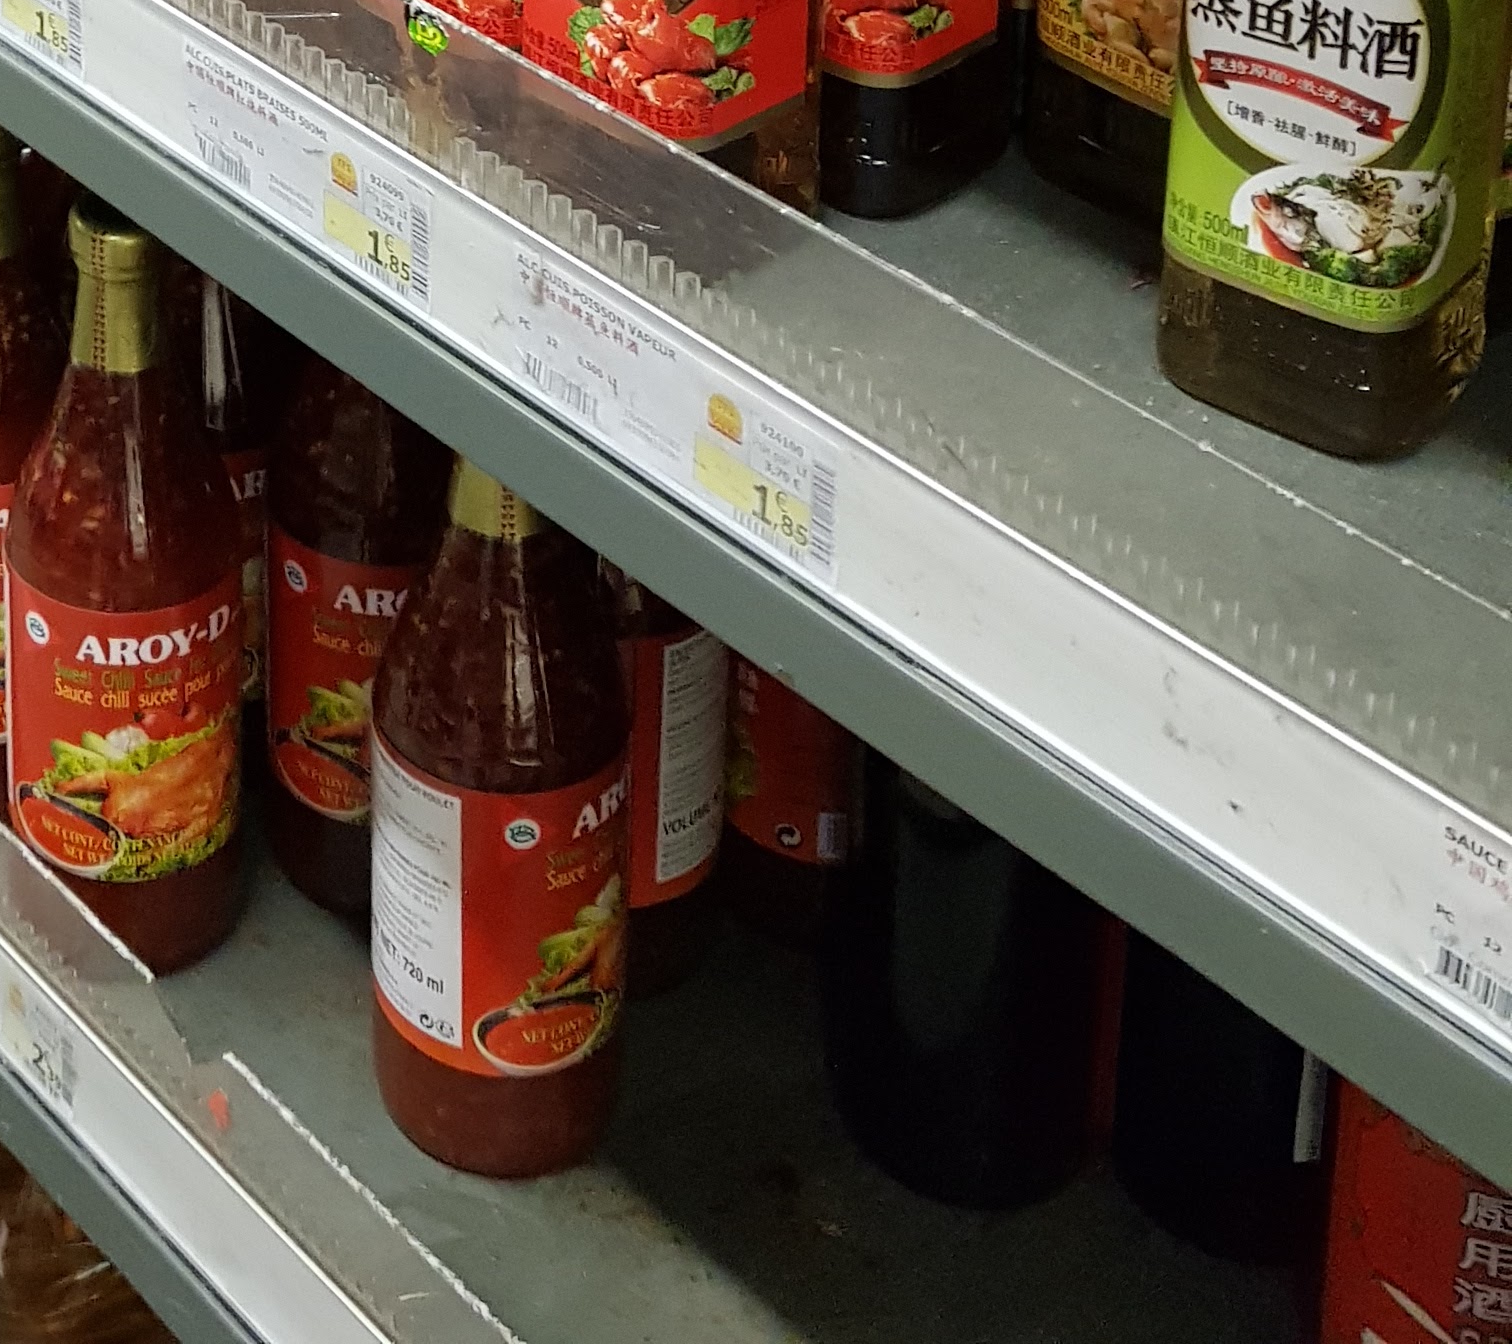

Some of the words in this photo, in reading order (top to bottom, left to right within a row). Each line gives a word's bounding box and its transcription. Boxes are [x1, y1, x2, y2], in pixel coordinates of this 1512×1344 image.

[256, 88, 296, 122] BRAISES
[298, 113, 330, 144] 500ML
[369, 173, 405, 202] 924095
[1202, 210, 1249, 244] 500ml
[628, 320, 678, 362] VAPEUR
[54, 677, 94, 706] Sauce
[184, 669, 212, 703] pour
[1444, 825, 1508, 874] SAUCE
[401, 956, 424, 984] 720
[426, 976, 445, 995] ml
